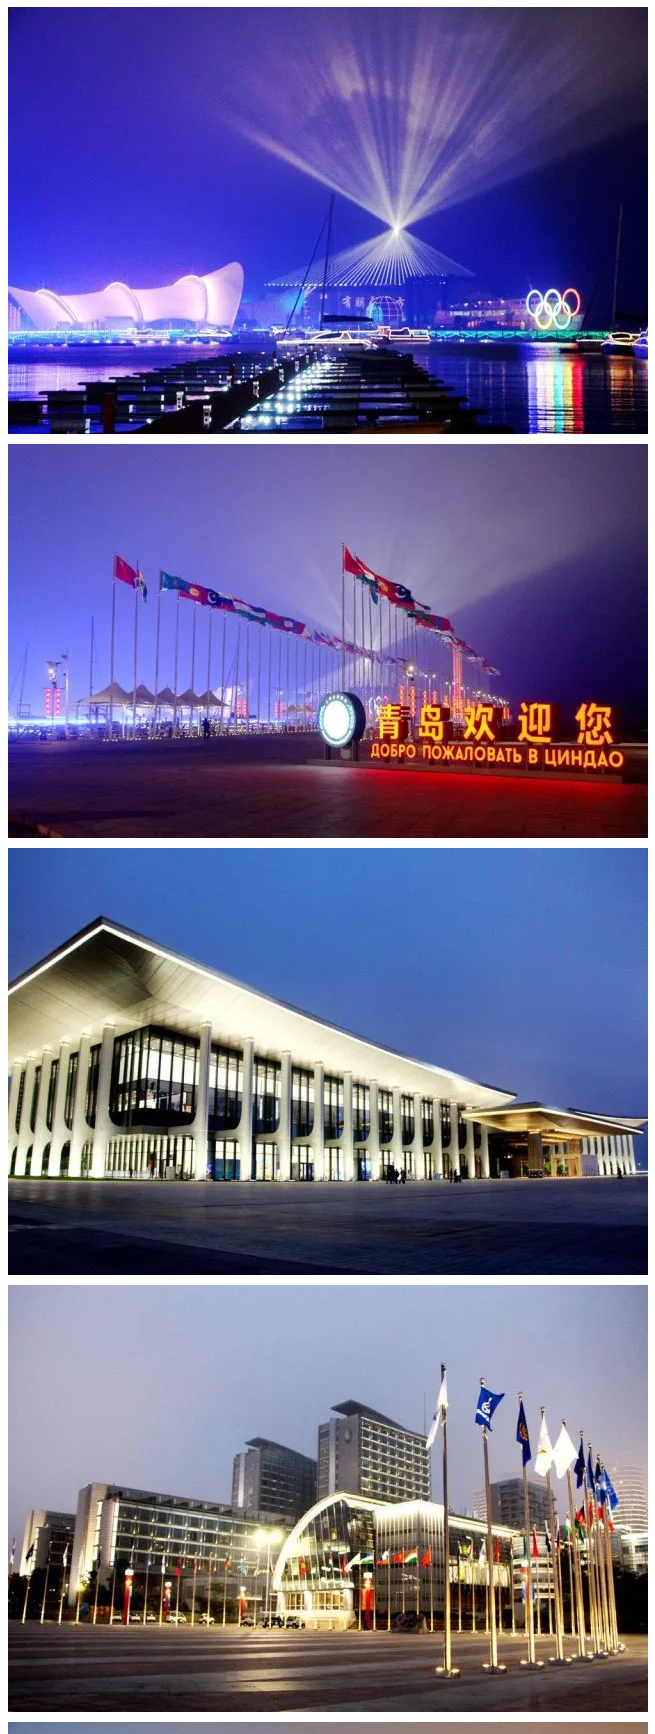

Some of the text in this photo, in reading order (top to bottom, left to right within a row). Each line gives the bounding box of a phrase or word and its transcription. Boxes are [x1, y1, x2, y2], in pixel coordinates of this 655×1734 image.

[377, 702, 613, 746] 青岛欢迎您
[370, 743, 624, 769] ДОБРО ПОЖАЛОВАТЬ В ЦИНДАО
